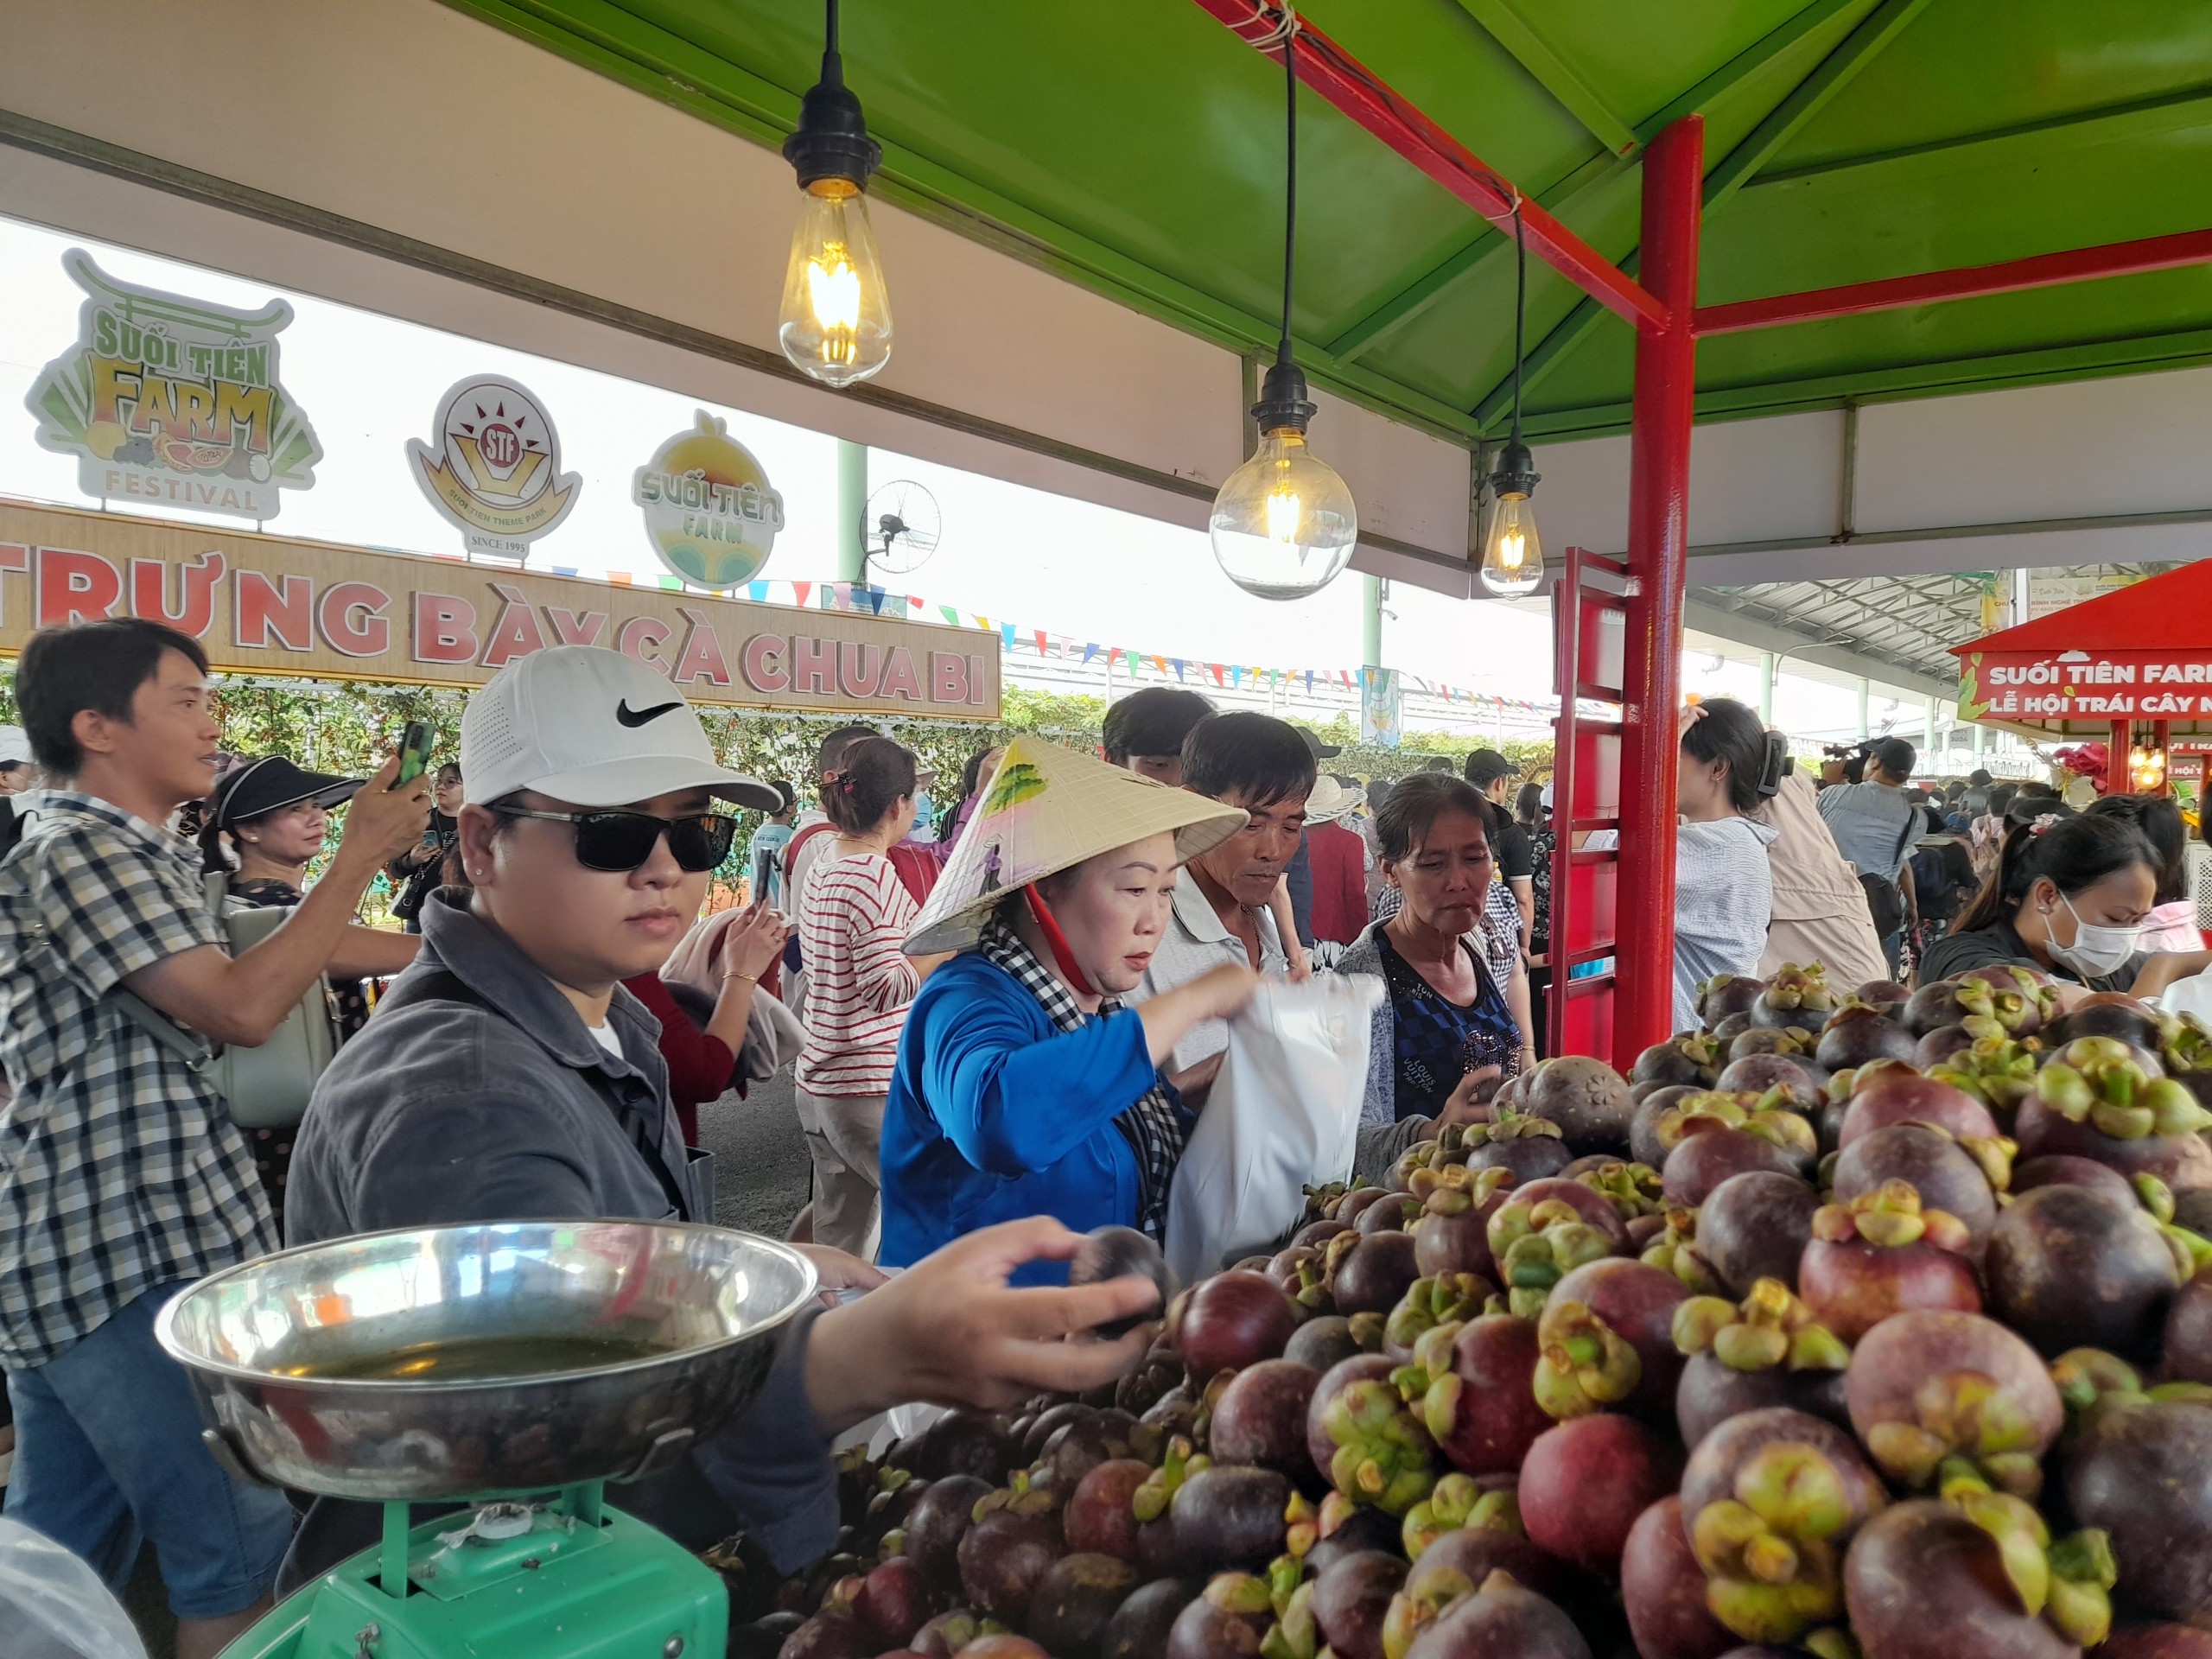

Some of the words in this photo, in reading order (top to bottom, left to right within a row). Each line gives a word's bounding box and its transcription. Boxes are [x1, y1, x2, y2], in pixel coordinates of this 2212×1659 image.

[188, 340, 267, 386] TIÊN
[88, 354, 273, 454] FARM
[486, 428, 515, 463] STF
[105, 470, 257, 512] FESTIVAL
[493, 517, 524, 526] THEME
[525, 506, 547, 523] PARK
[683, 513, 743, 543] FARM
[471, 536, 503, 550] SINCE
[505, 541, 525, 553] 1995
[620, 609, 733, 686] CÀ
[744, 632, 924, 700] CHUA
[932, 651, 985, 705] BI
[1989, 659, 2059, 684] SUỐI
[2067, 660, 2136, 683] TIÊN
[2144, 664, 2212, 683] FAR
[1990, 690, 2018, 713] LỄ
[2024, 693, 2069, 716] HỘI
[2075, 692, 2134, 713] TRÁI
[2140, 692, 2195, 713] CÂY
[1403, 1058, 1434, 1094] VUITTON
[1414, 1059, 1436, 1086] LOUIS
